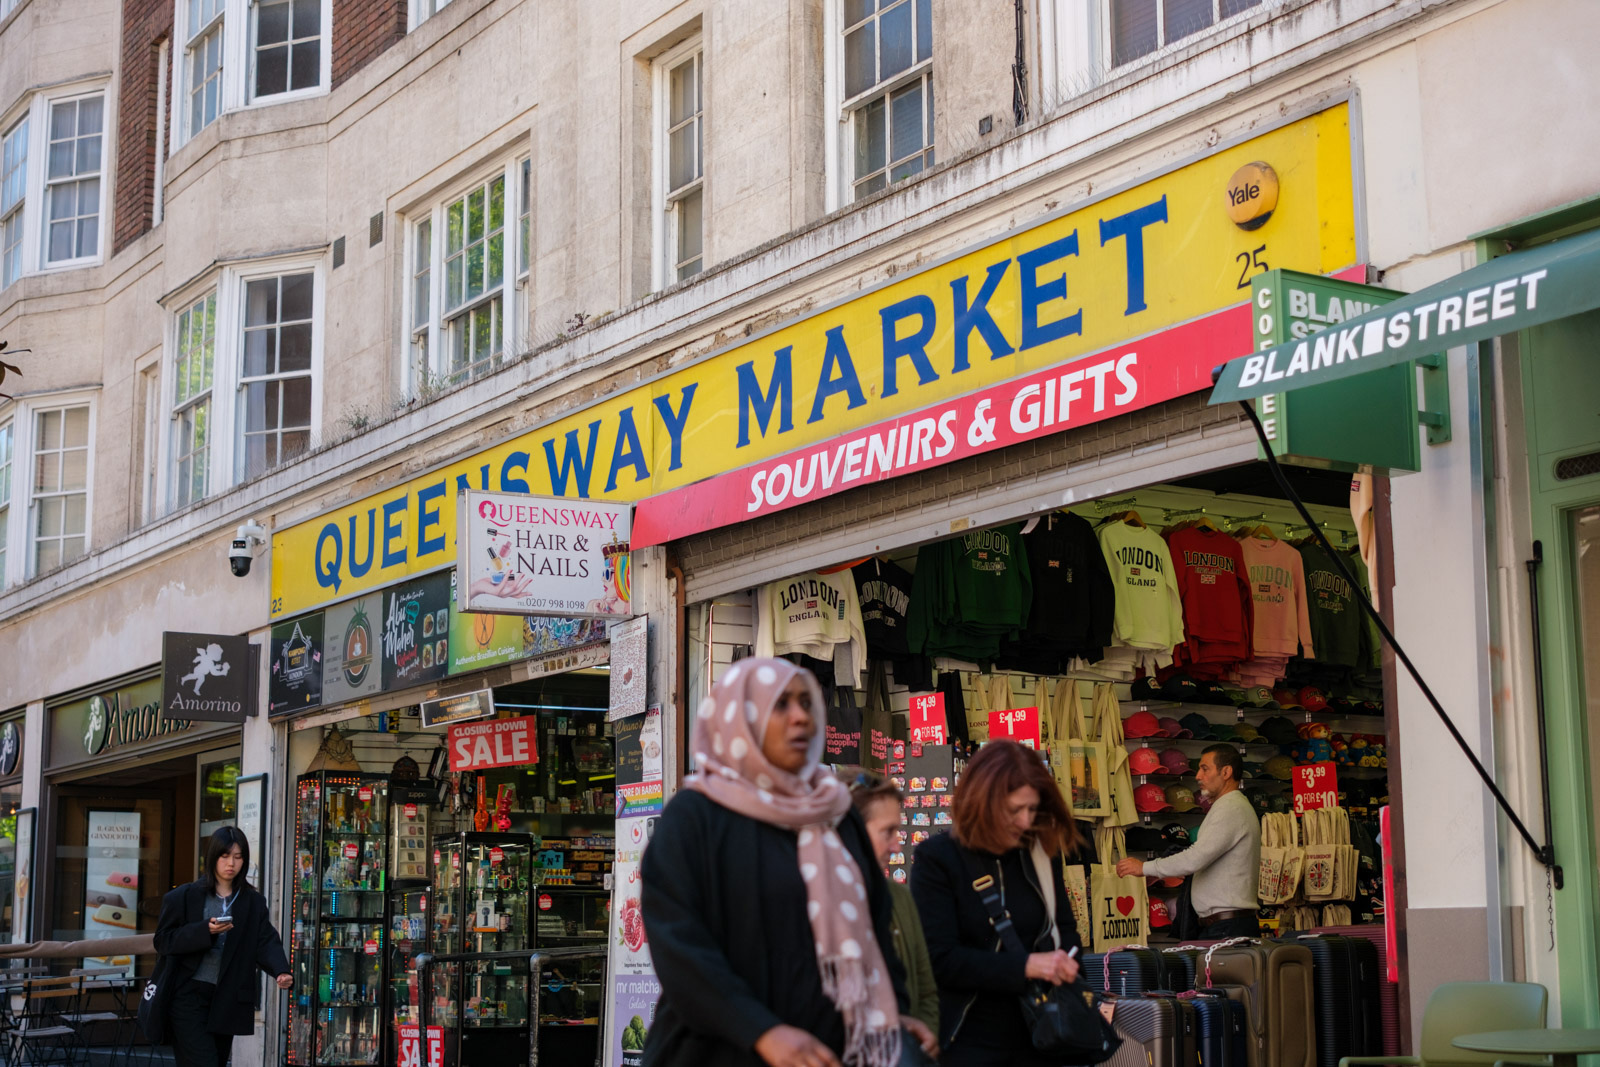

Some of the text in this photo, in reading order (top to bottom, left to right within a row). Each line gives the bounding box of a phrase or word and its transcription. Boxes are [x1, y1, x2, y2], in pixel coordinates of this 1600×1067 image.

[1228, 181, 1260, 207] Yale
[1236, 244, 1269, 290] 25
[736, 194, 1168, 449] MARKET
[1238, 269, 1548, 388] BLANK STREET
[1257, 288, 1277, 440] COEE
[747, 352, 1138, 513] SOUVENIRS & GIFTS
[478, 500, 619, 530] QUEENSWAY
[515, 529, 590, 552] HAIR &
[516, 551, 589, 578] NAILS
[1184, 550, 1235, 574] LONDON
[1126, 577, 1157, 587] GLAND
[1250, 565, 1293, 592] ONDON
[525, 598, 546, 607] 0207
[548, 599, 564, 608] 998
[566, 600, 585, 610] 1098
[780, 579, 840, 611] LONDON
[455, 646, 516, 667] Authentic Brazilian Cuisine
[169, 692, 242, 713] Amorino
[916, 695, 936, 721] £1.99
[454, 720, 527, 737] CLOSING DOWN
[871, 729, 882, 737] the
[999, 709, 1027, 736] £1.99
[826, 740, 858, 748] shopping
[921, 726, 931, 738] FOR
[931, 725, 943, 746] £5
[455, 730, 529, 768] SALE
[1302, 766, 1325, 788] £3.99
[617, 787, 635, 798] STORE
[1295, 791, 1337, 814] 3 FOR £10
[1104, 897, 1115, 918] I
[1102, 918, 1140, 940] LONDON
[629, 980, 660, 994] matcha
[427, 1029, 441, 1039] OWN
[401, 1039, 441, 1067] SAE
